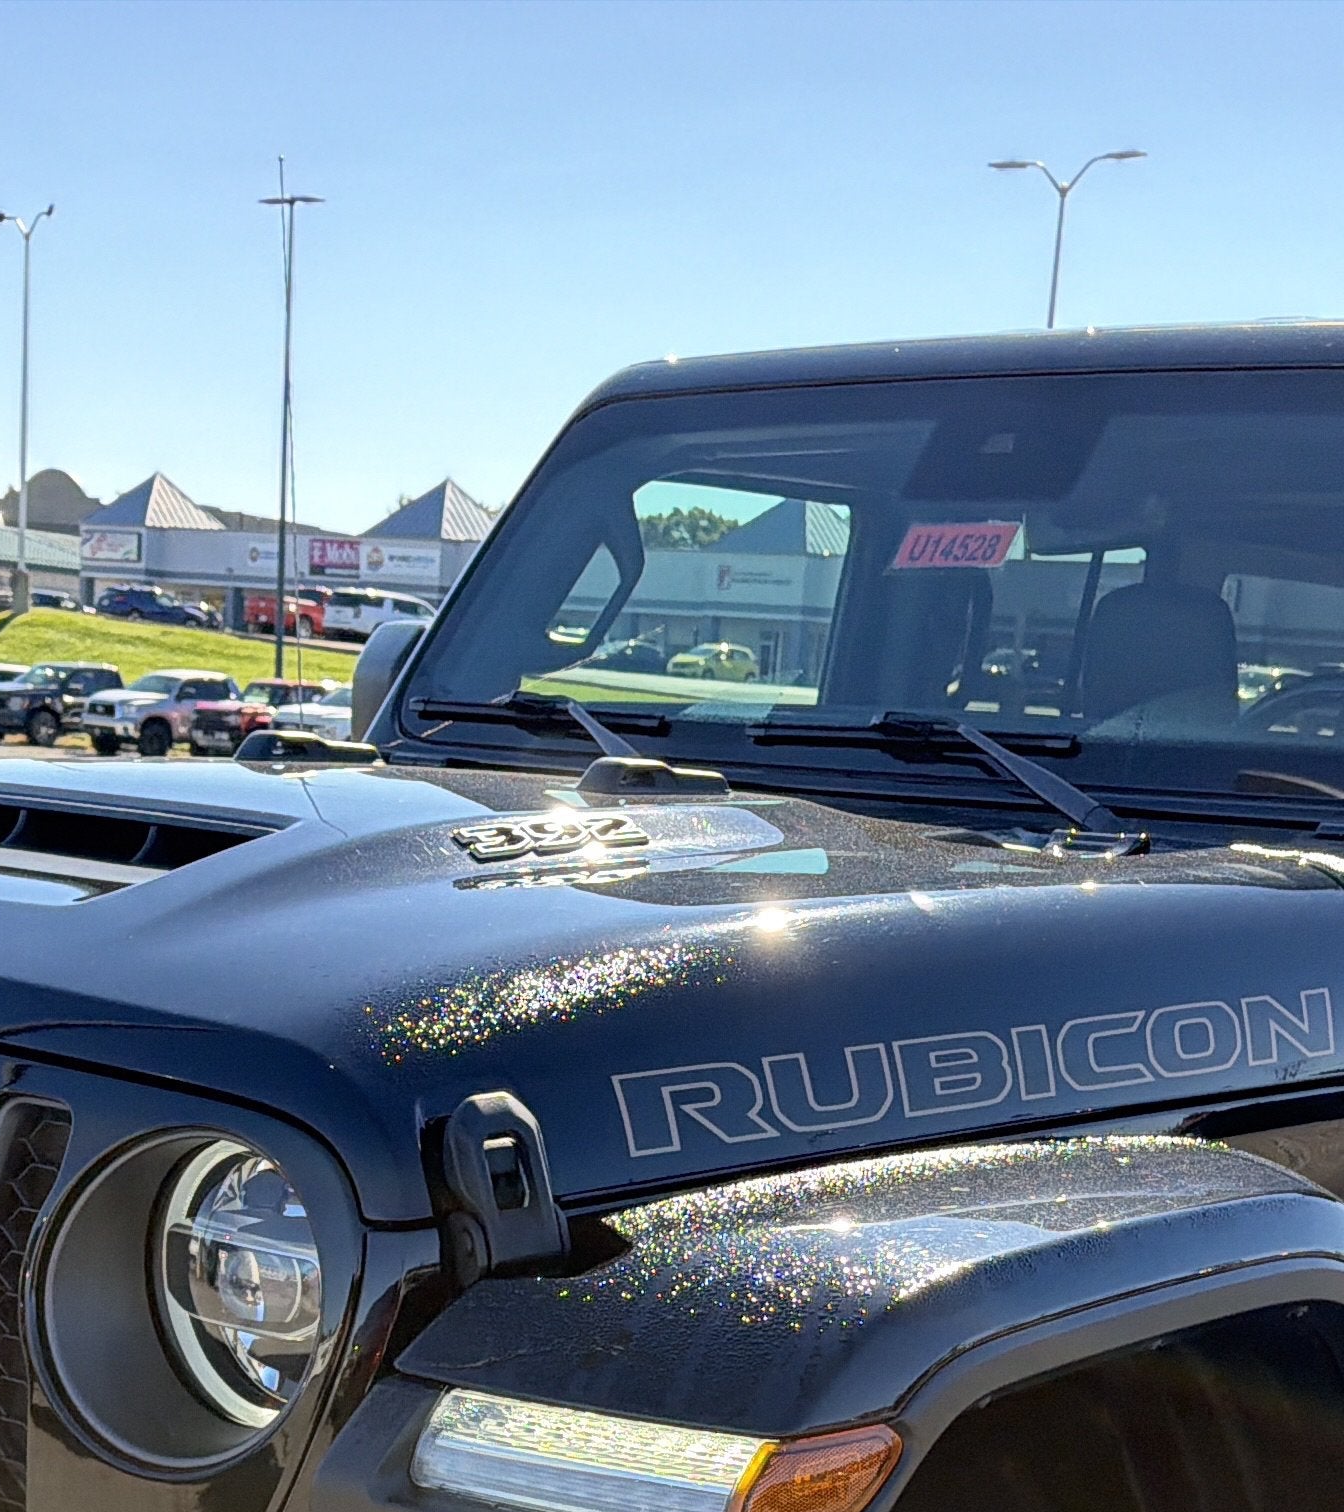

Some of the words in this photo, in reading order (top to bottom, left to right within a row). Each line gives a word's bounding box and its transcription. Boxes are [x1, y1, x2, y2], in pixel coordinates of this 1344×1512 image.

[908, 533, 1002, 562] U14528
[450, 812, 650, 864] 392
[611, 987, 1336, 1158] RUBICON
